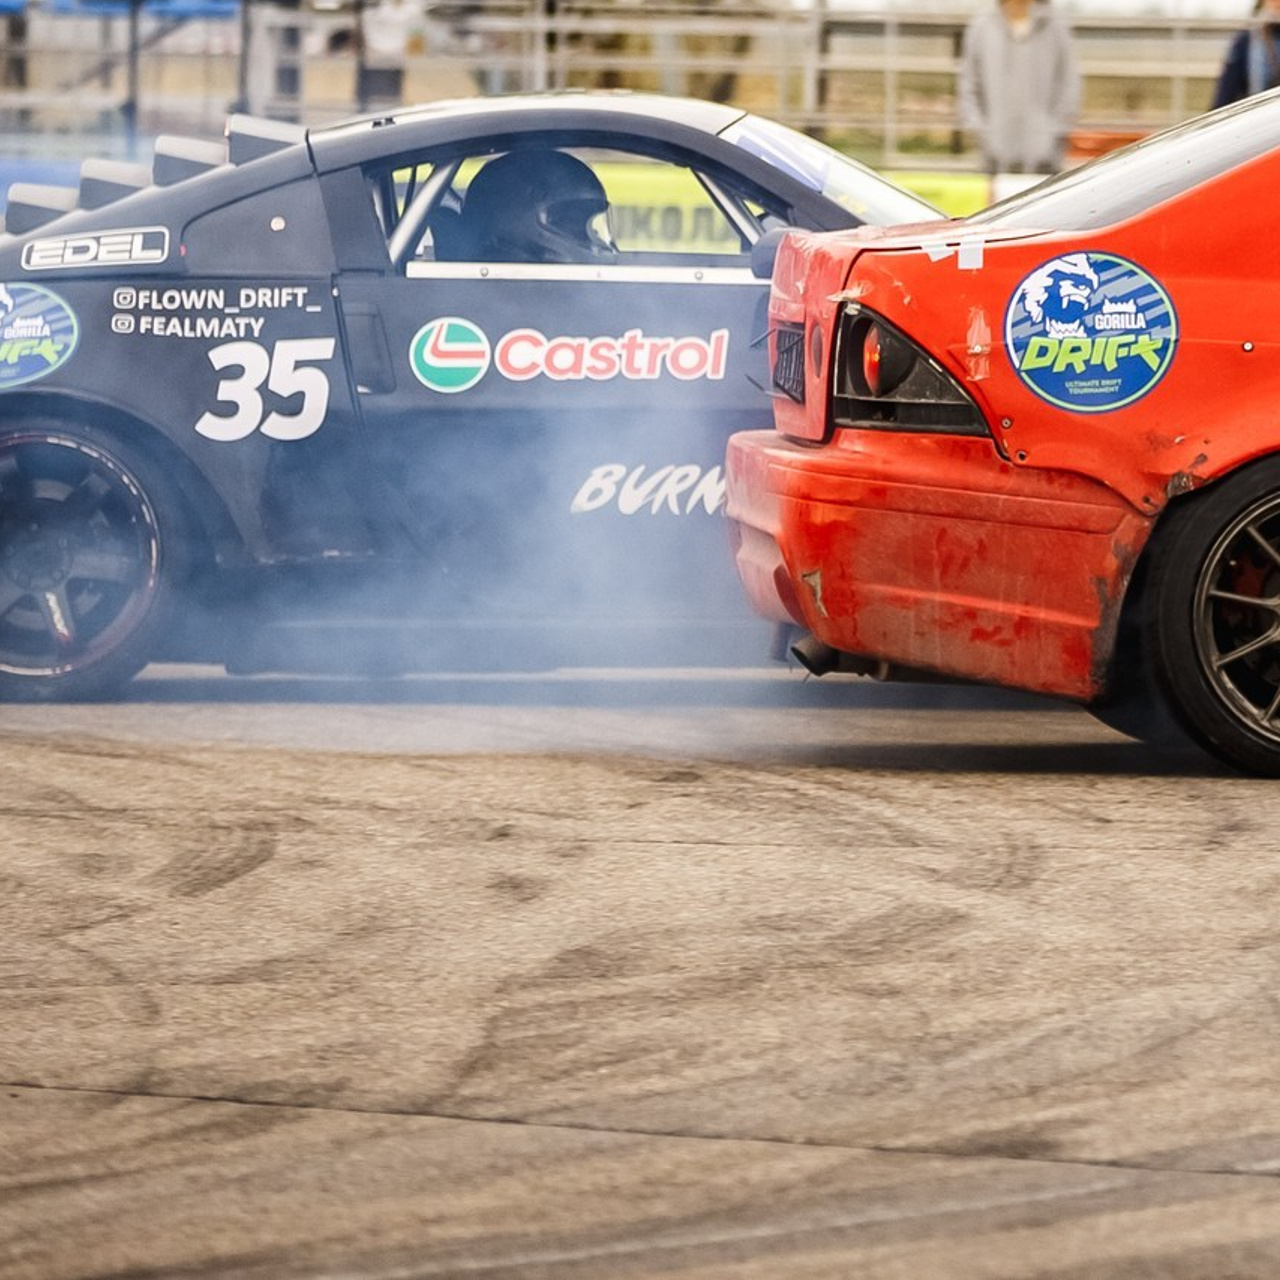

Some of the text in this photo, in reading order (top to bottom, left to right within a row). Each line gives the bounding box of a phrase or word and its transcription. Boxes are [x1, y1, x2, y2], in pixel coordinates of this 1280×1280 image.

[30, 233, 163, 265] EDEL
[138, 287, 322, 313] FLOWN_DRIFT_
[140, 317, 265, 338] FEALMATY
[1095, 313, 1146, 330] GORILLA
[496, 329, 729, 380] Castrol
[195, 338, 335, 441] 35
